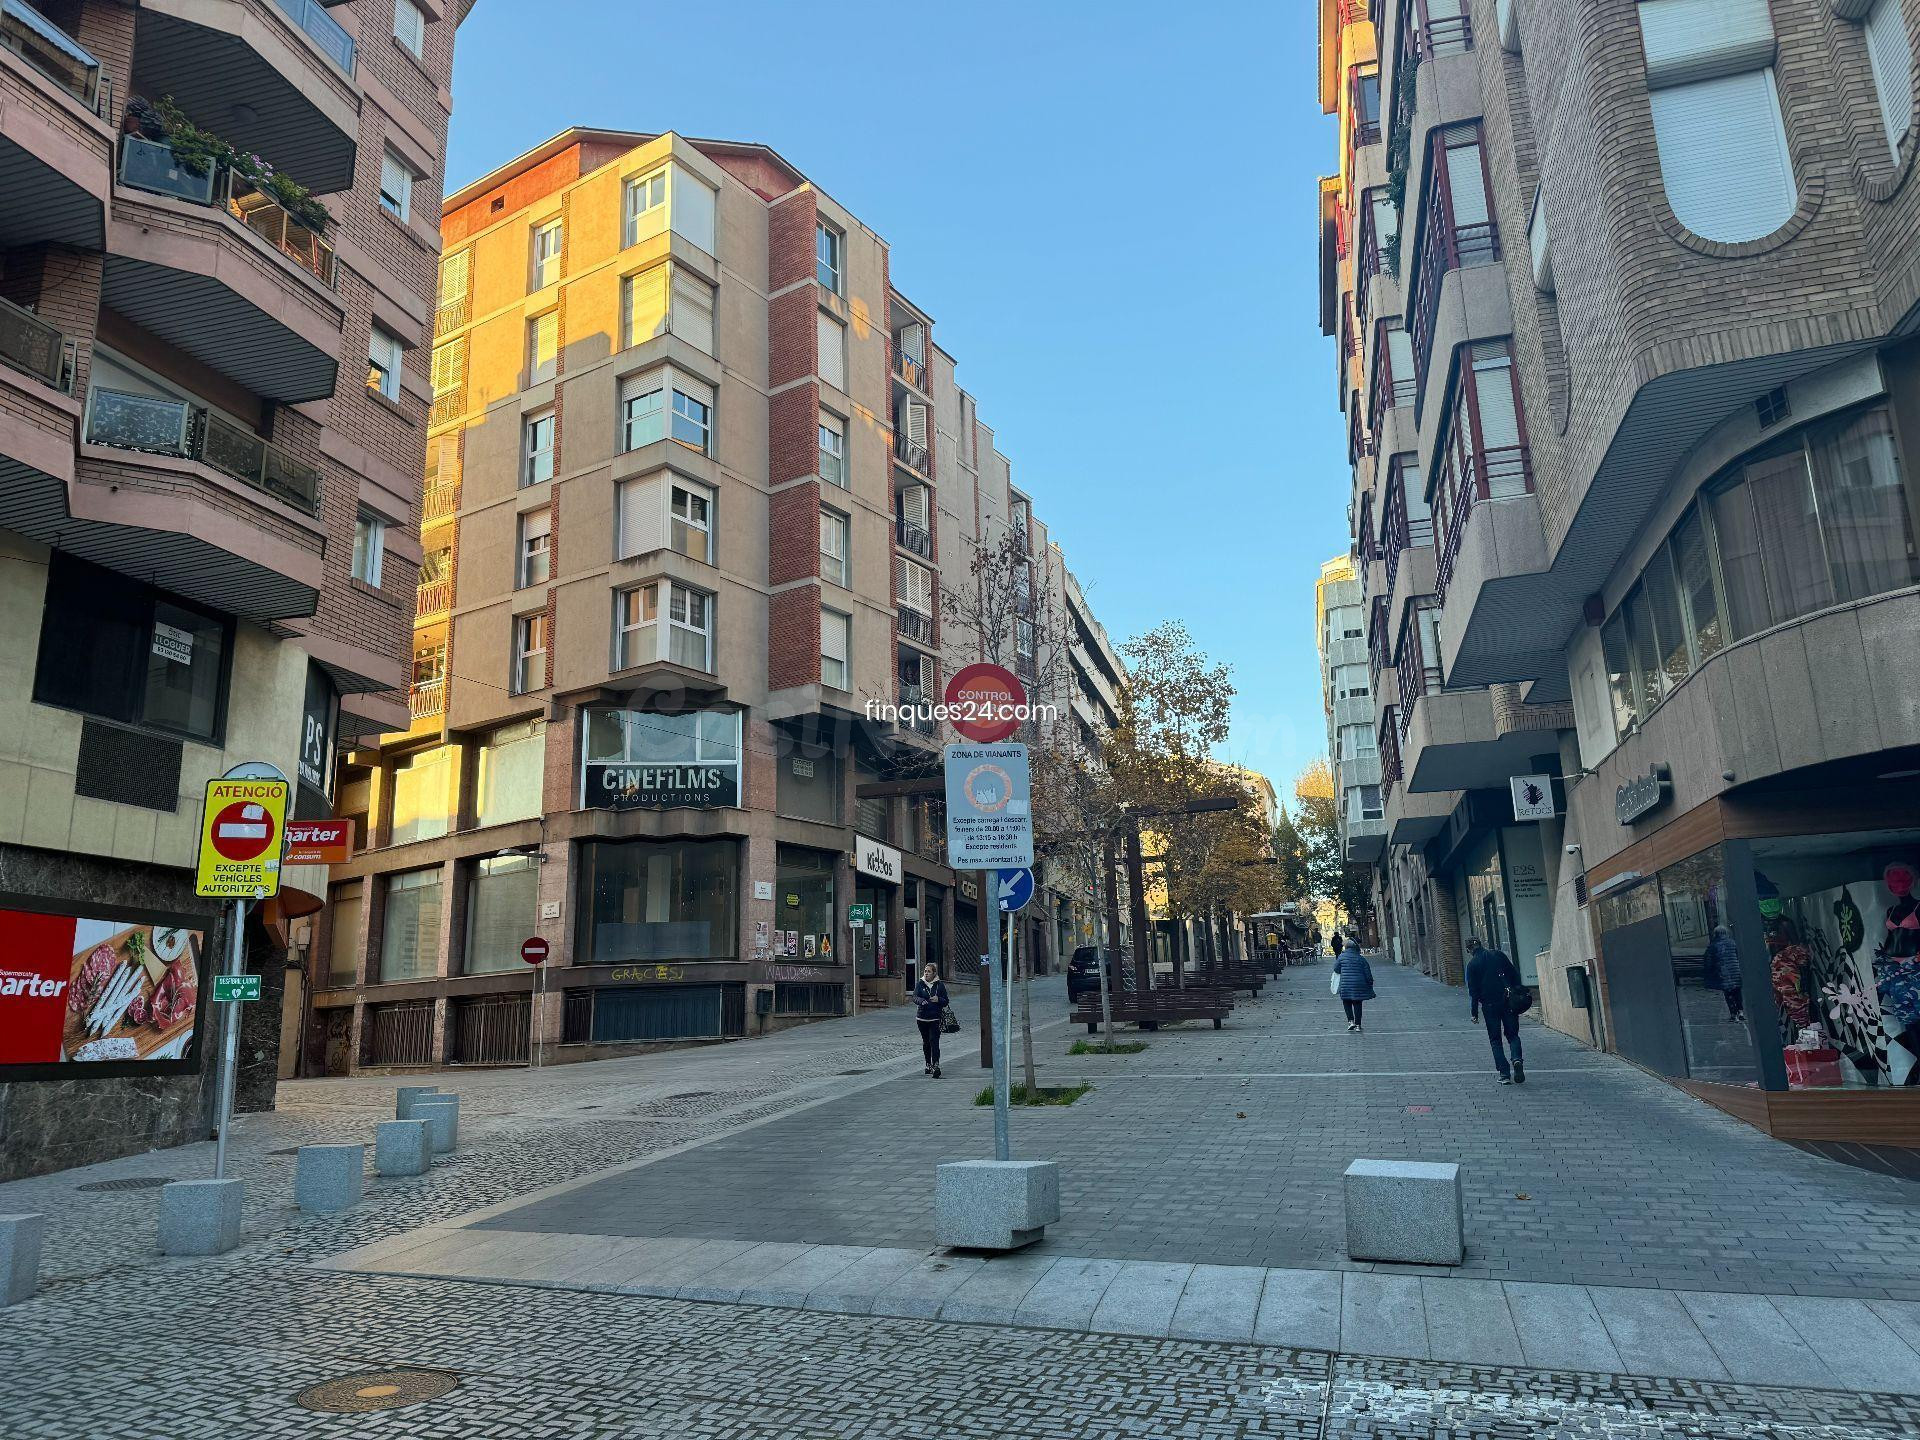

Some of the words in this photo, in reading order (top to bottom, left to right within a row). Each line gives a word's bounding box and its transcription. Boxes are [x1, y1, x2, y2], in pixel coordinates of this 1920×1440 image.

[155, 635, 191, 655] LLOGUER
[957, 690, 1015, 701] CONTROL
[985, 750, 1022, 758] VIANANTS
[213, 783, 283, 798] ATENCIÓ
[613, 793, 710, 802] PRODUCTIONS
[965, 843, 990, 851] Excepte
[215, 864, 262, 873] EXCEPTE
[213, 872, 262, 883] VEHÍCLES
